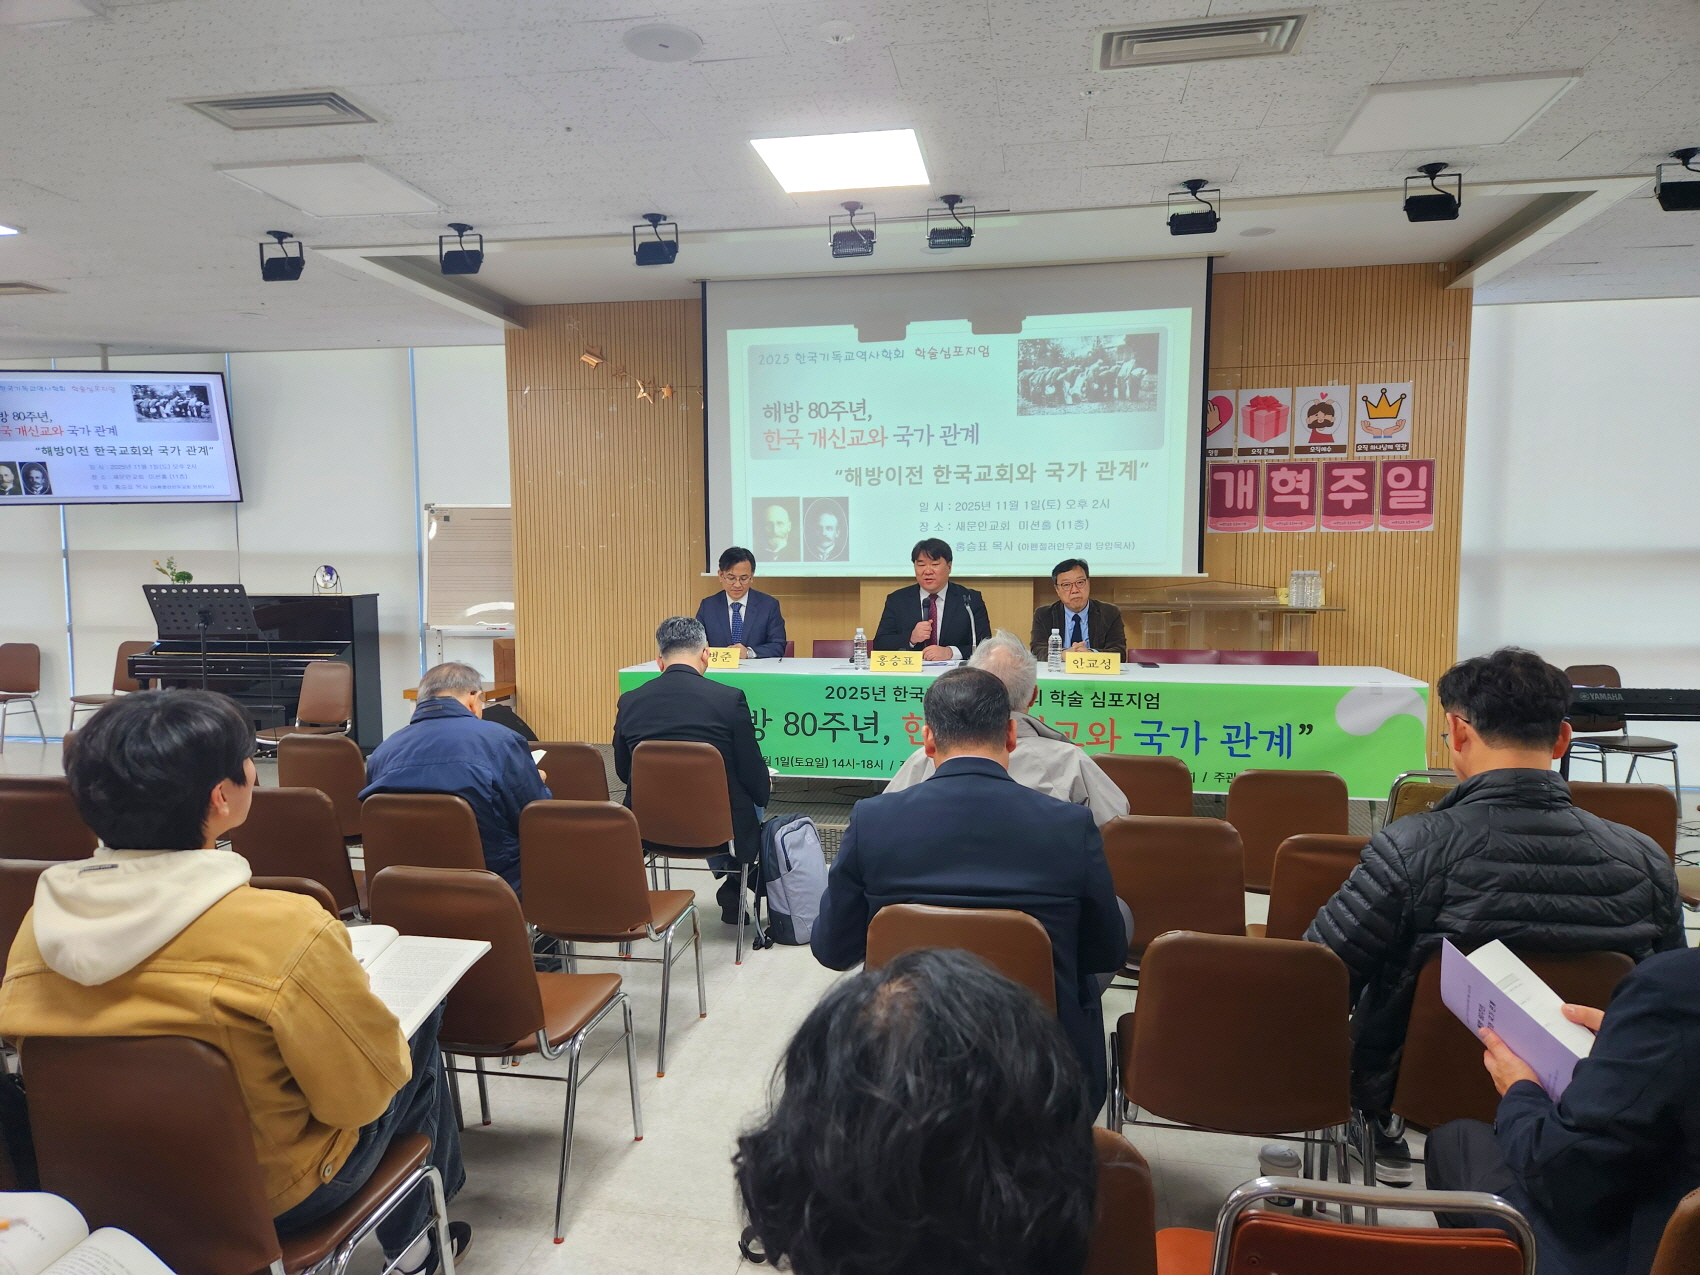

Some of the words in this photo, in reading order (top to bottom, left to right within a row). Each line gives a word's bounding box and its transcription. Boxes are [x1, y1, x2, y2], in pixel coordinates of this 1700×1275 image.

[758, 353, 790, 366] 2025
[795, 347, 905, 365] 한국기독교역사학회
[914, 344, 991, 360] 학술심포지엄
[0, 411, 9, 423] 방
[12, 410, 53, 423] 80주년,
[762, 400, 804, 424] 해방
[807, 398, 873, 423] 80주년,
[0, 425, 12, 437] 국
[15, 425, 64, 437] 개신교와
[67, 425, 91, 437] 국가
[94, 425, 118, 437] 관계
[763, 428, 804, 450] 한국
[807, 425, 889, 450] 개신교와
[892, 424, 935, 447] 국가
[939, 422, 980, 446] 관계
[94, 445, 153, 457] 한국교회와
[158, 445, 181, 456] 국가
[932, 462, 1037, 486] 한국교회와
[1044, 461, 1087, 483] 국가
[919, 502, 929, 512] 일
[933, 501, 944, 512] 시
[955, 501, 991, 512] 2025년
[996, 500, 1019, 512] 11월
[1024, 498, 1061, 511] 1일(토)
[1065, 498, 1089, 510] 오후
[1092, 498, 1110, 510] 2시
[919, 521, 929, 532] 장
[933, 521, 944, 532] 소
[955, 520, 1010, 532] 새문안교회
[1018, 519, 1052, 531] 미션홀
[1056, 518, 1089, 531] (11층)
[955, 541, 988, 552] 홍승표
[992, 540, 1014, 552] 목사
[709, 651, 732, 663] 병준
[876, 654, 915, 667] 홍승표
[1072, 657, 1112, 670] 안교성
[825, 685, 887, 702] 2025년
[893, 686, 925, 703] 한국
[1050, 689, 1084, 708] 학술
[1090, 690, 1161, 710] 심포지엄
[1589, 692, 1624, 701] YAMAHA
[750, 707, 773, 742] 방
[783, 710, 890, 746] 80주년,
[1055, 717, 1123, 753] 교와
[1133, 719, 1208, 757] 국가
[774, 755, 829, 769] 1일(토요일)
[832, 758, 884, 771] 14시-18시
